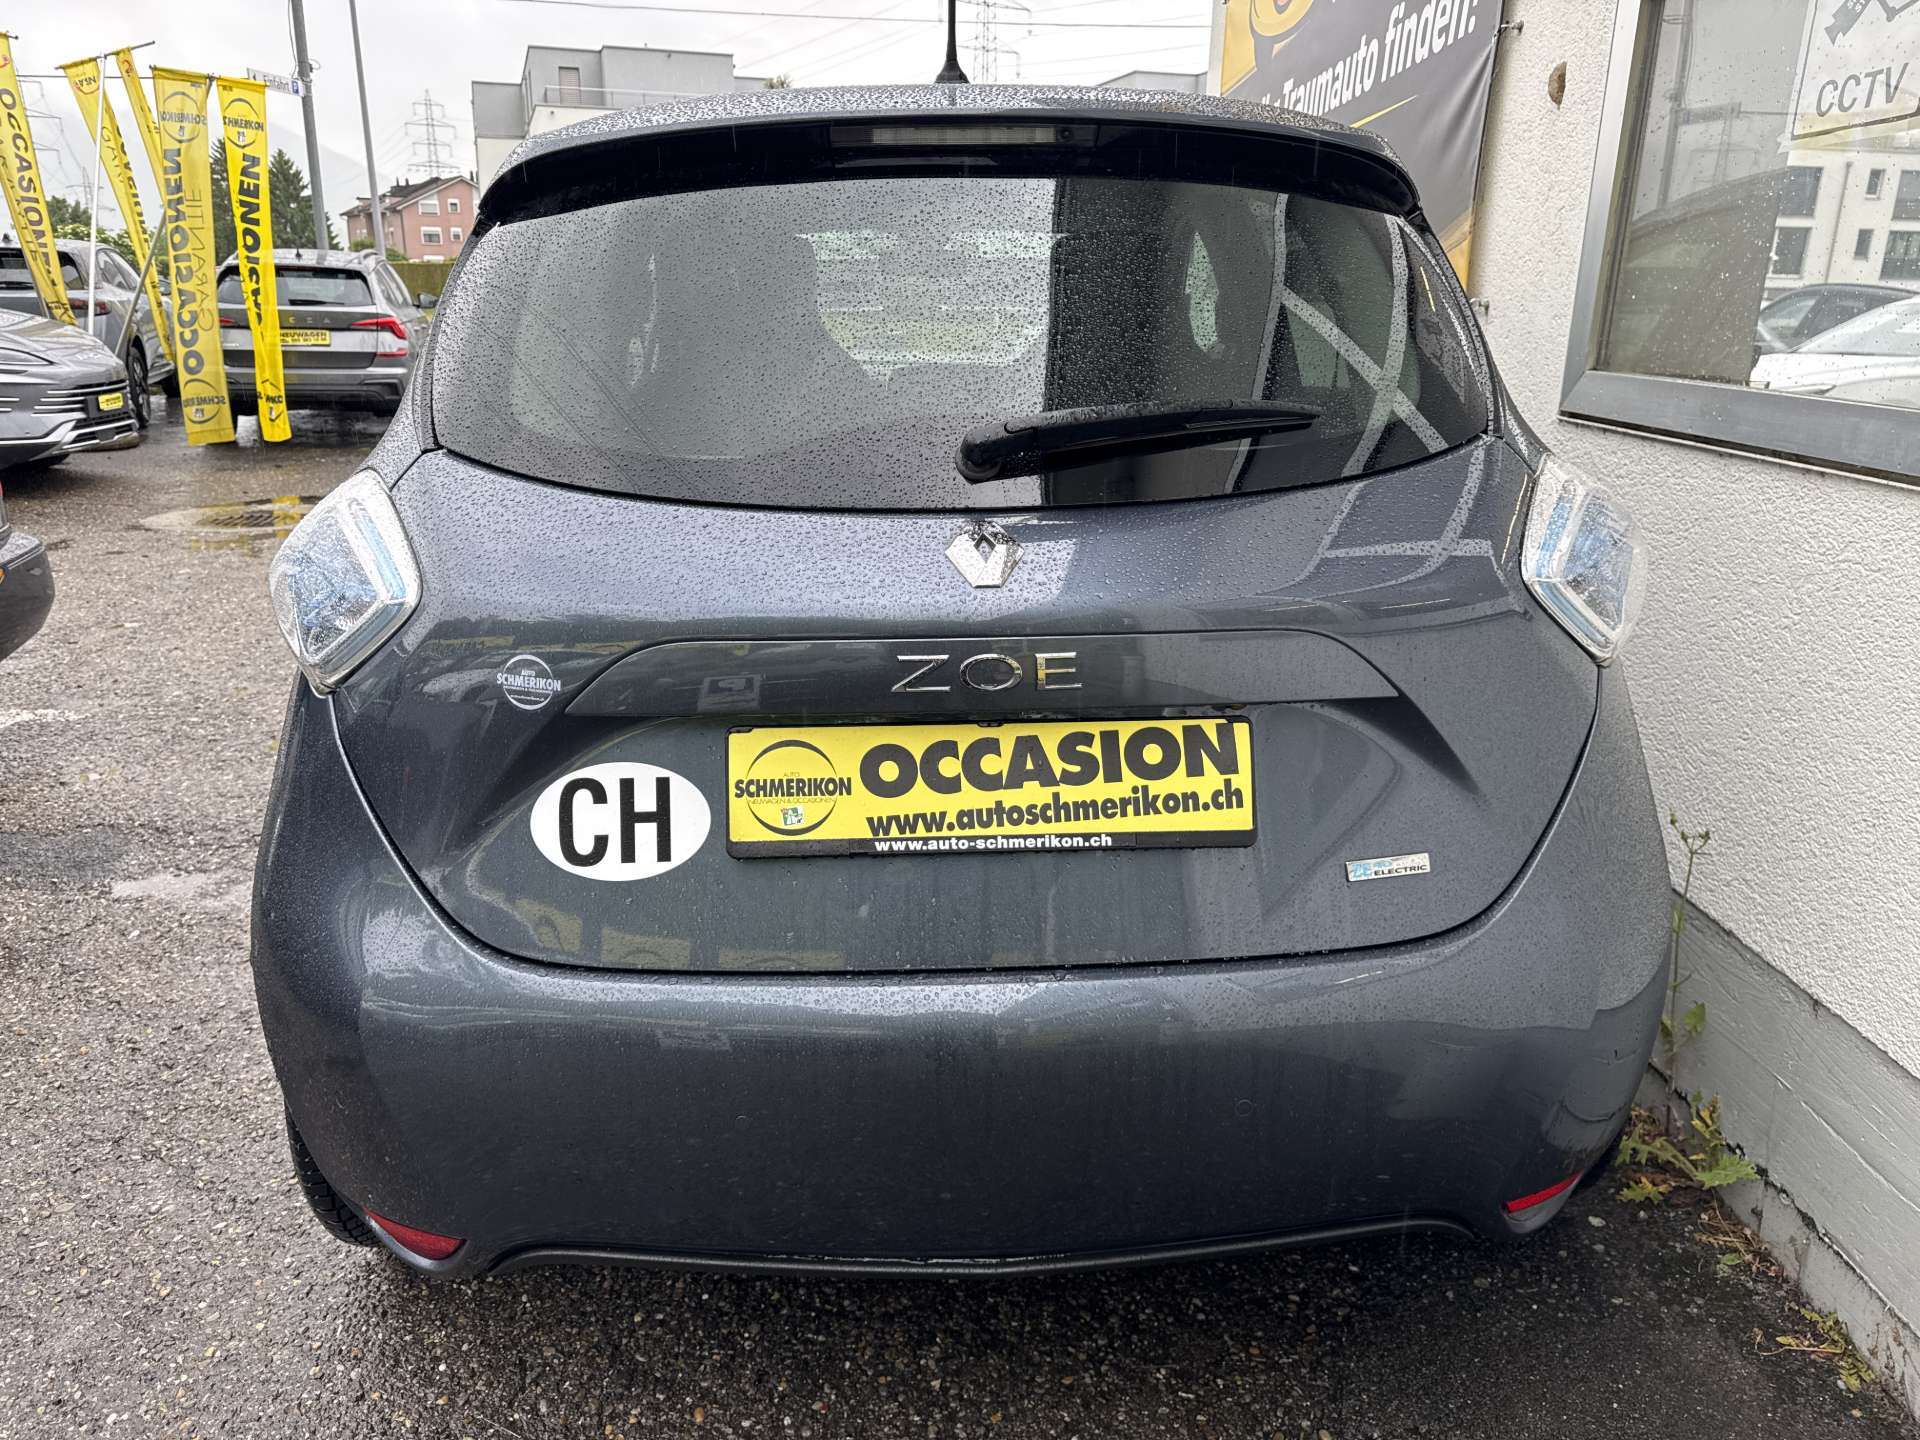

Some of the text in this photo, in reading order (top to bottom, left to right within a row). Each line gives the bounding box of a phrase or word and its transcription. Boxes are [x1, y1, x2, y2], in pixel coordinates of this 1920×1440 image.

[1282, 34, 1379, 117] Traumauto
[1816, 62, 1909, 117] CCTV
[497, 673, 561, 691] SCHMERIKON
[891, 652, 1083, 693] ZOE
[859, 722, 1240, 799] OCCASION
[735, 777, 852, 798] SCHMERIKON
[866, 779, 1244, 838] www.autoschmerikon.ch
[559, 776, 671, 867] CH
[875, 834, 1112, 852] www.auto-schmerikon.ch
[1374, 864, 1428, 876] ELECTRIC
